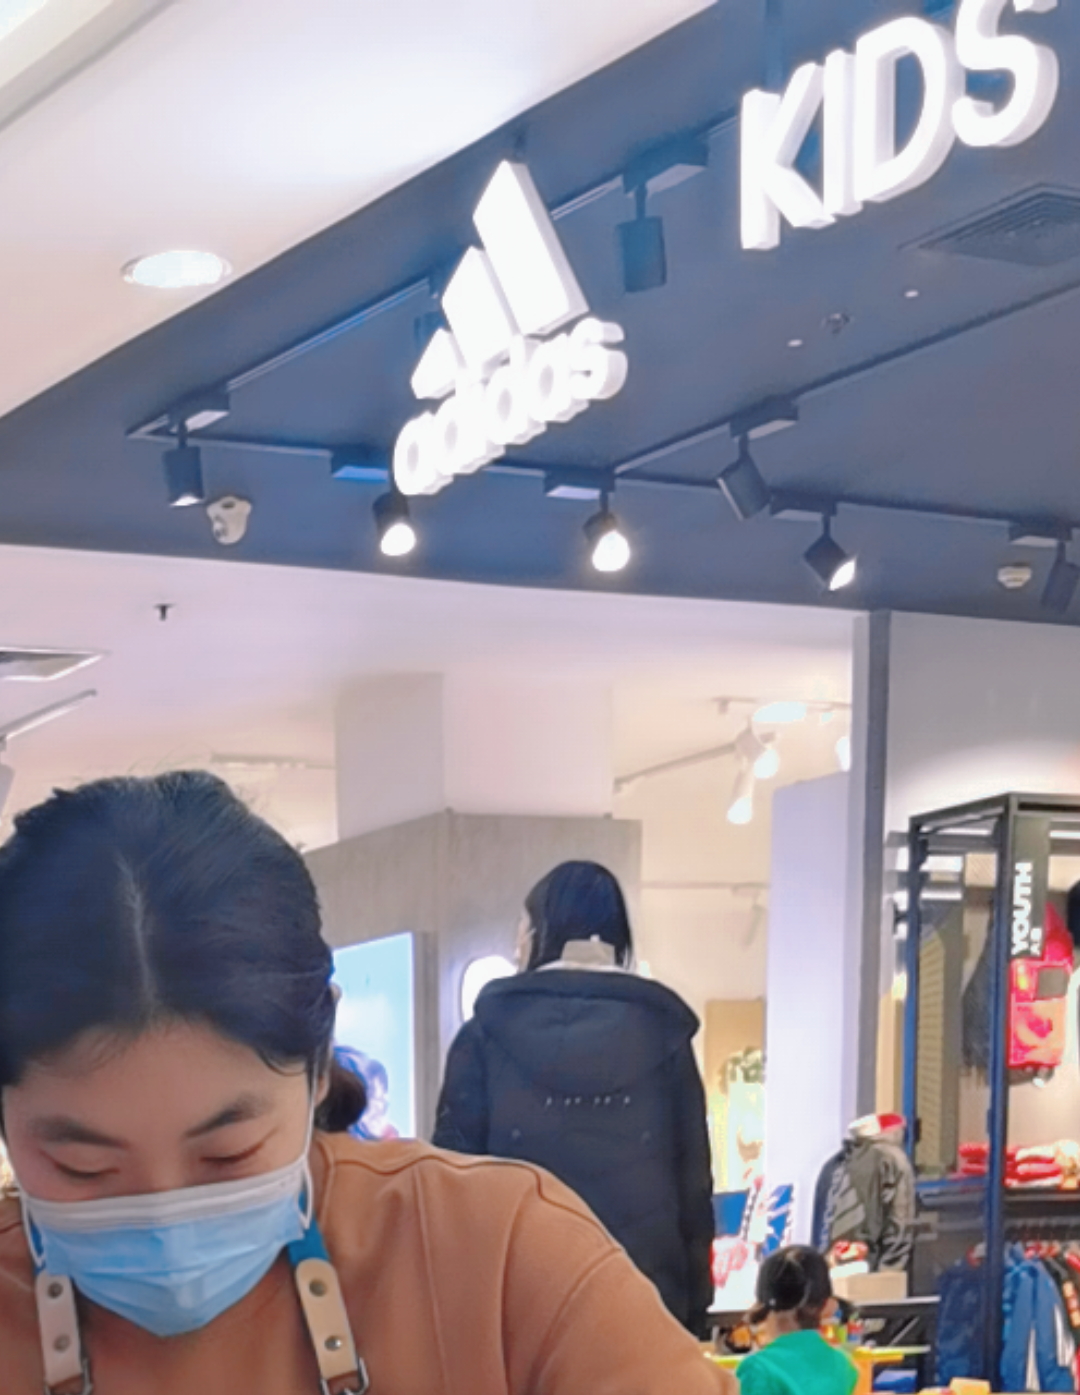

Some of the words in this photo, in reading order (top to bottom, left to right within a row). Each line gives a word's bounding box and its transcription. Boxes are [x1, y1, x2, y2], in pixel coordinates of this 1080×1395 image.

[740, 0, 1060, 250] KIDS
[393, 317, 629, 496] adidas
[1011, 862, 1033, 956] YOUTH
